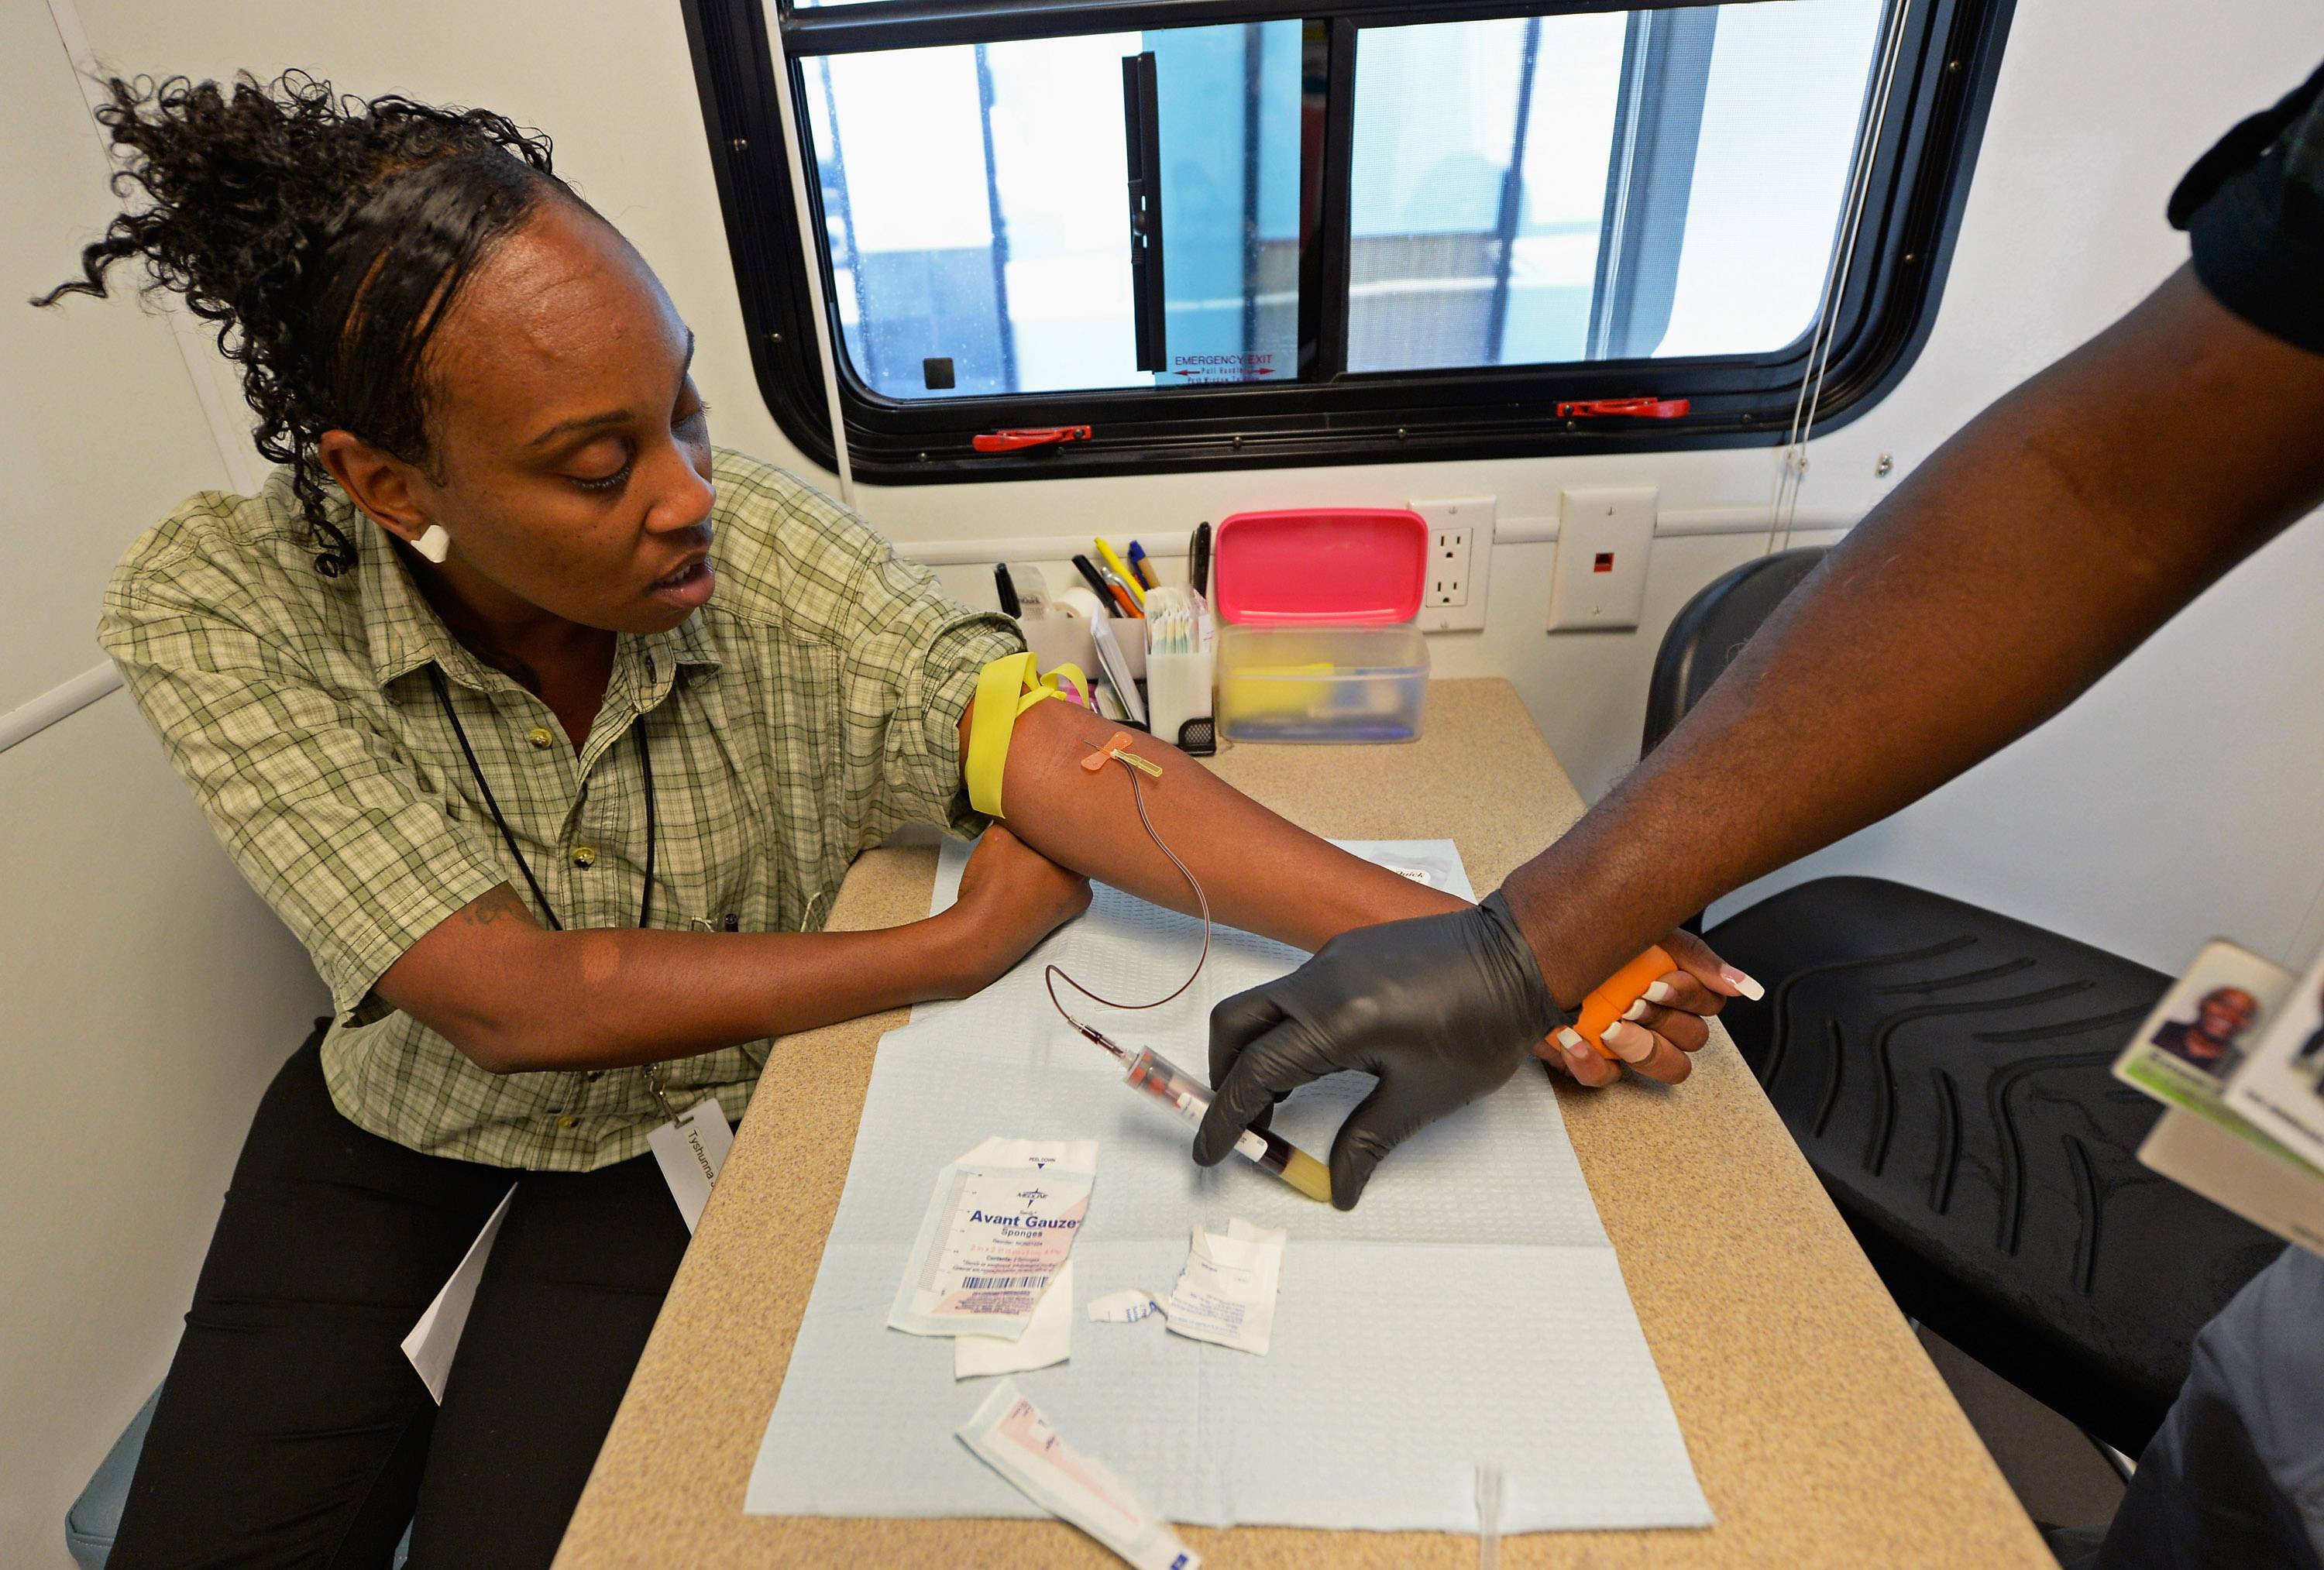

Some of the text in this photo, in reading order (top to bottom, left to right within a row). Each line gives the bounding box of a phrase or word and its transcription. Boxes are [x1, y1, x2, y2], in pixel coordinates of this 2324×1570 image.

[1175, 354, 1273, 366] EMERGENCY EXIT
[688, 1129, 715, 1180] Tyshunna
[970, 1210, 1077, 1229] Avant Gauze
[1002, 1227, 1043, 1238] Sponges
